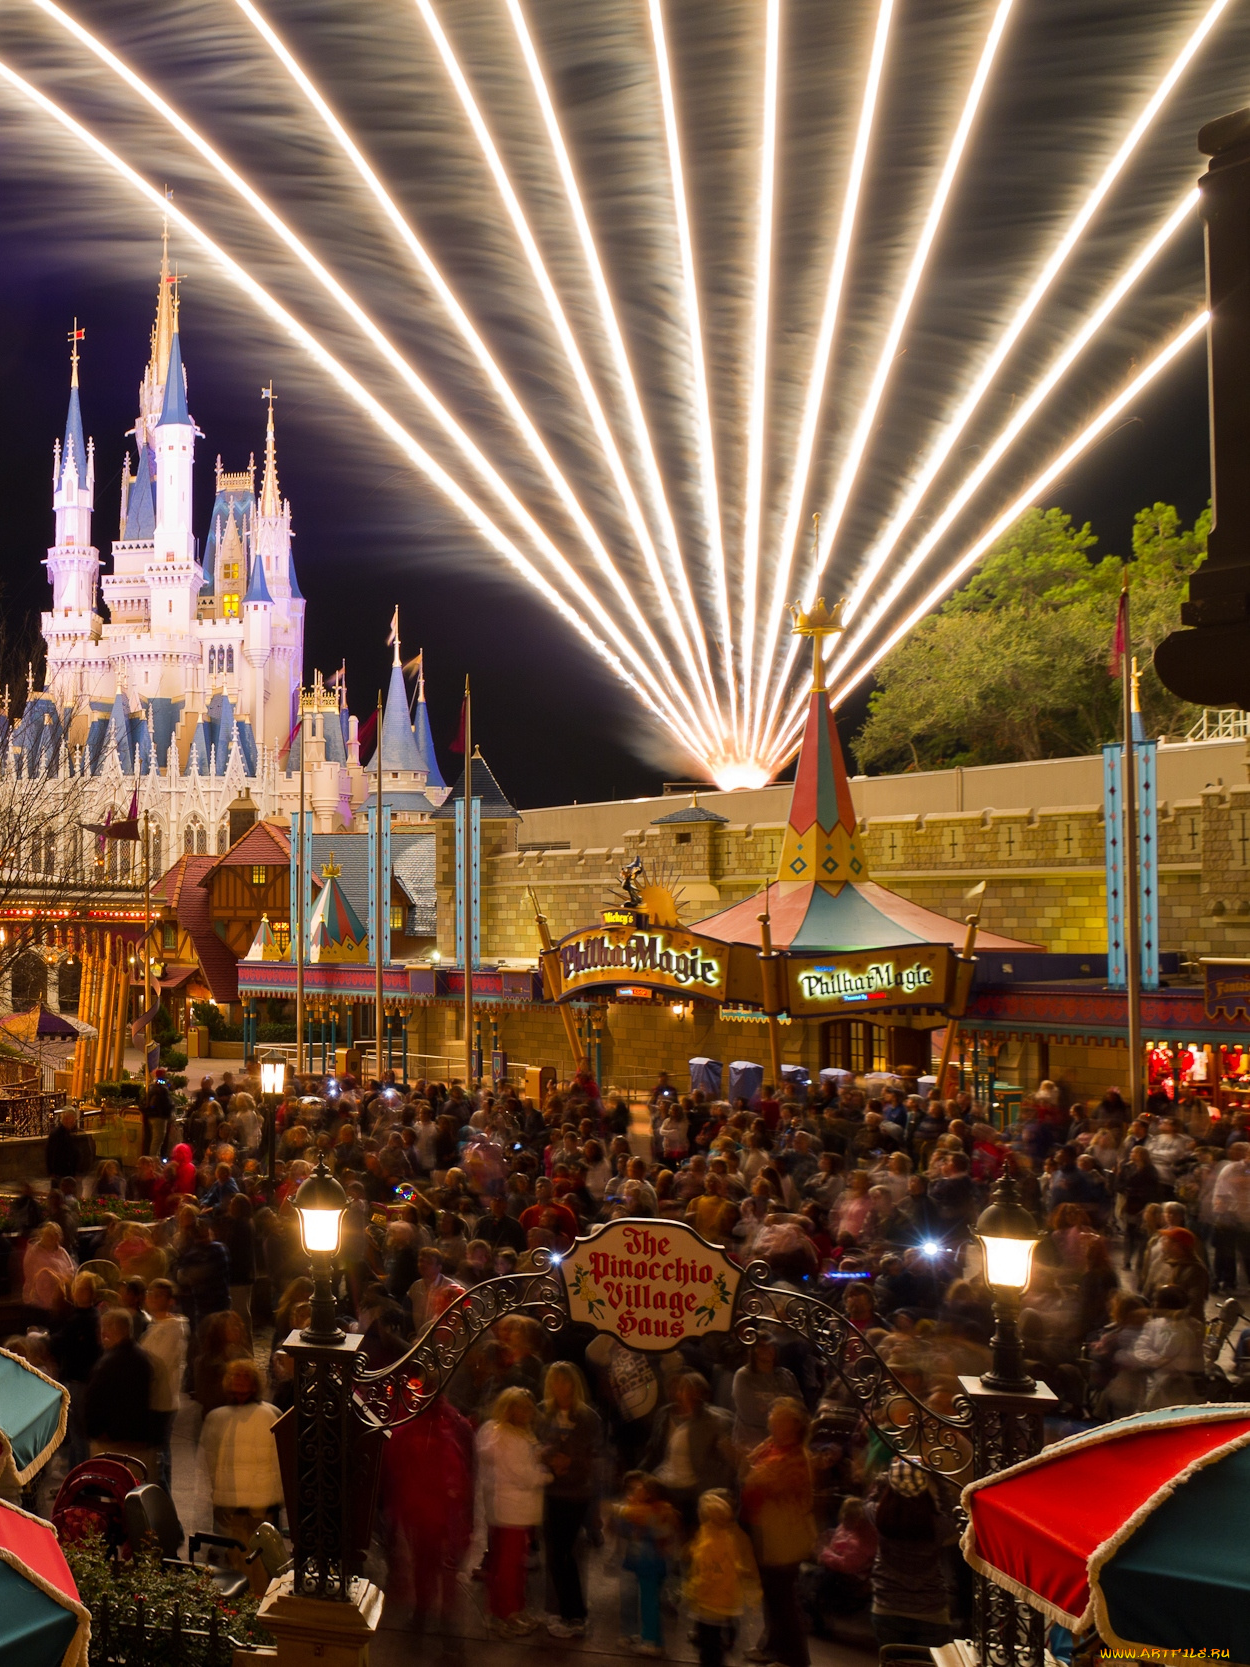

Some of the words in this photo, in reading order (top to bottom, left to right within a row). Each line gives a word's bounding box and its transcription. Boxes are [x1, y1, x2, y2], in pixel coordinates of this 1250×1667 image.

[603, 911, 634, 925] Mickey's
[561, 933, 717, 984] PhilharMagic
[801, 962, 933, 997] PhilharMagic
[622, 1227, 671, 1261] The
[588, 1252, 713, 1289] Pinocchio
[603, 1281, 699, 1319] Village
[616, 1309, 685, 1338] Haus
